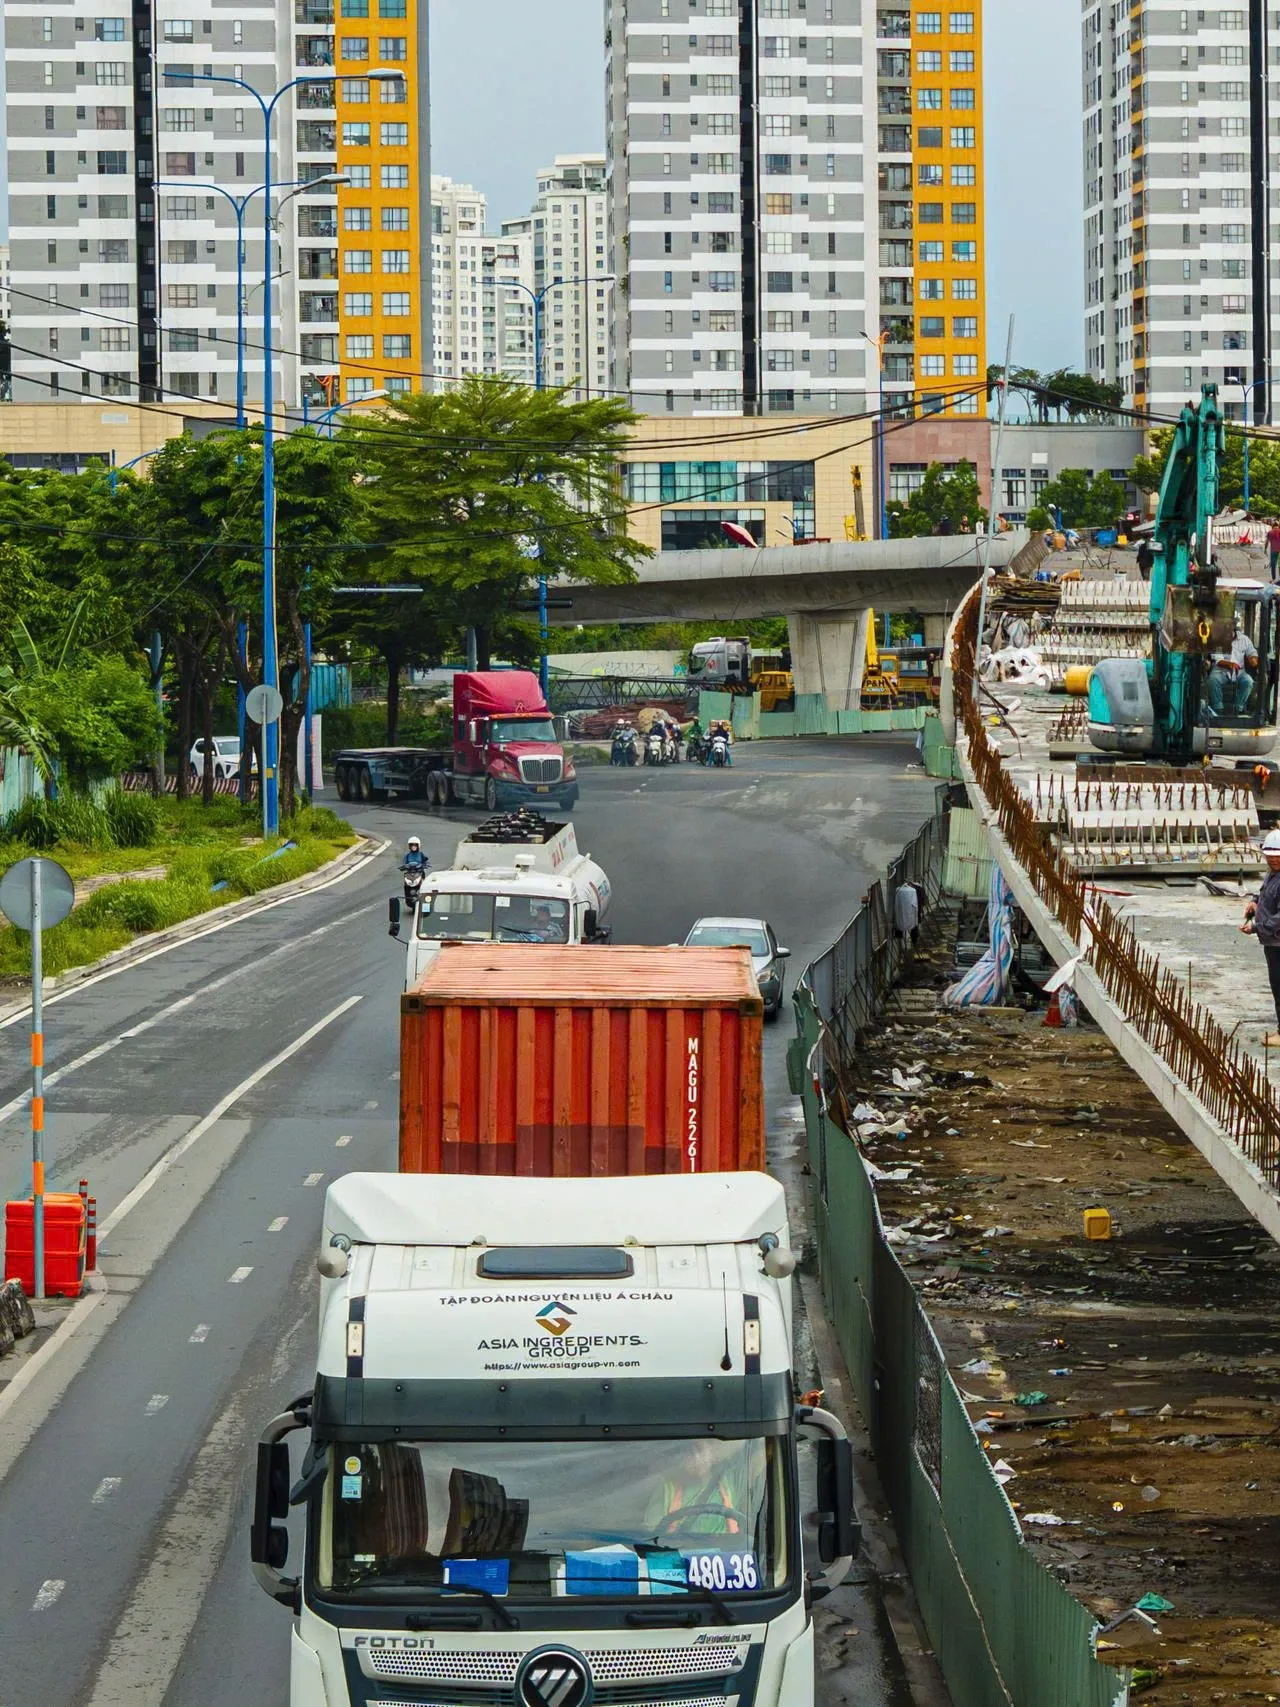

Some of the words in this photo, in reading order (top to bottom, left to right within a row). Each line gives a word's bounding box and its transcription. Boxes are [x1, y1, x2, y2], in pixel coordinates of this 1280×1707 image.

[688, 1037, 699, 1102] MAGU
[687, 1108, 698, 1172] 2261
[518, 1292, 580, 1302] NGUYÊN
[583, 1292, 612, 1302] LIỆU
[477, 1338, 519, 1350] ASIA
[523, 1335, 641, 1348] INGREDIENTS
[528, 1347, 590, 1358] GROUP
[688, 1553, 757, 1590] 480.36
[354, 1636, 435, 1649] FOTON
